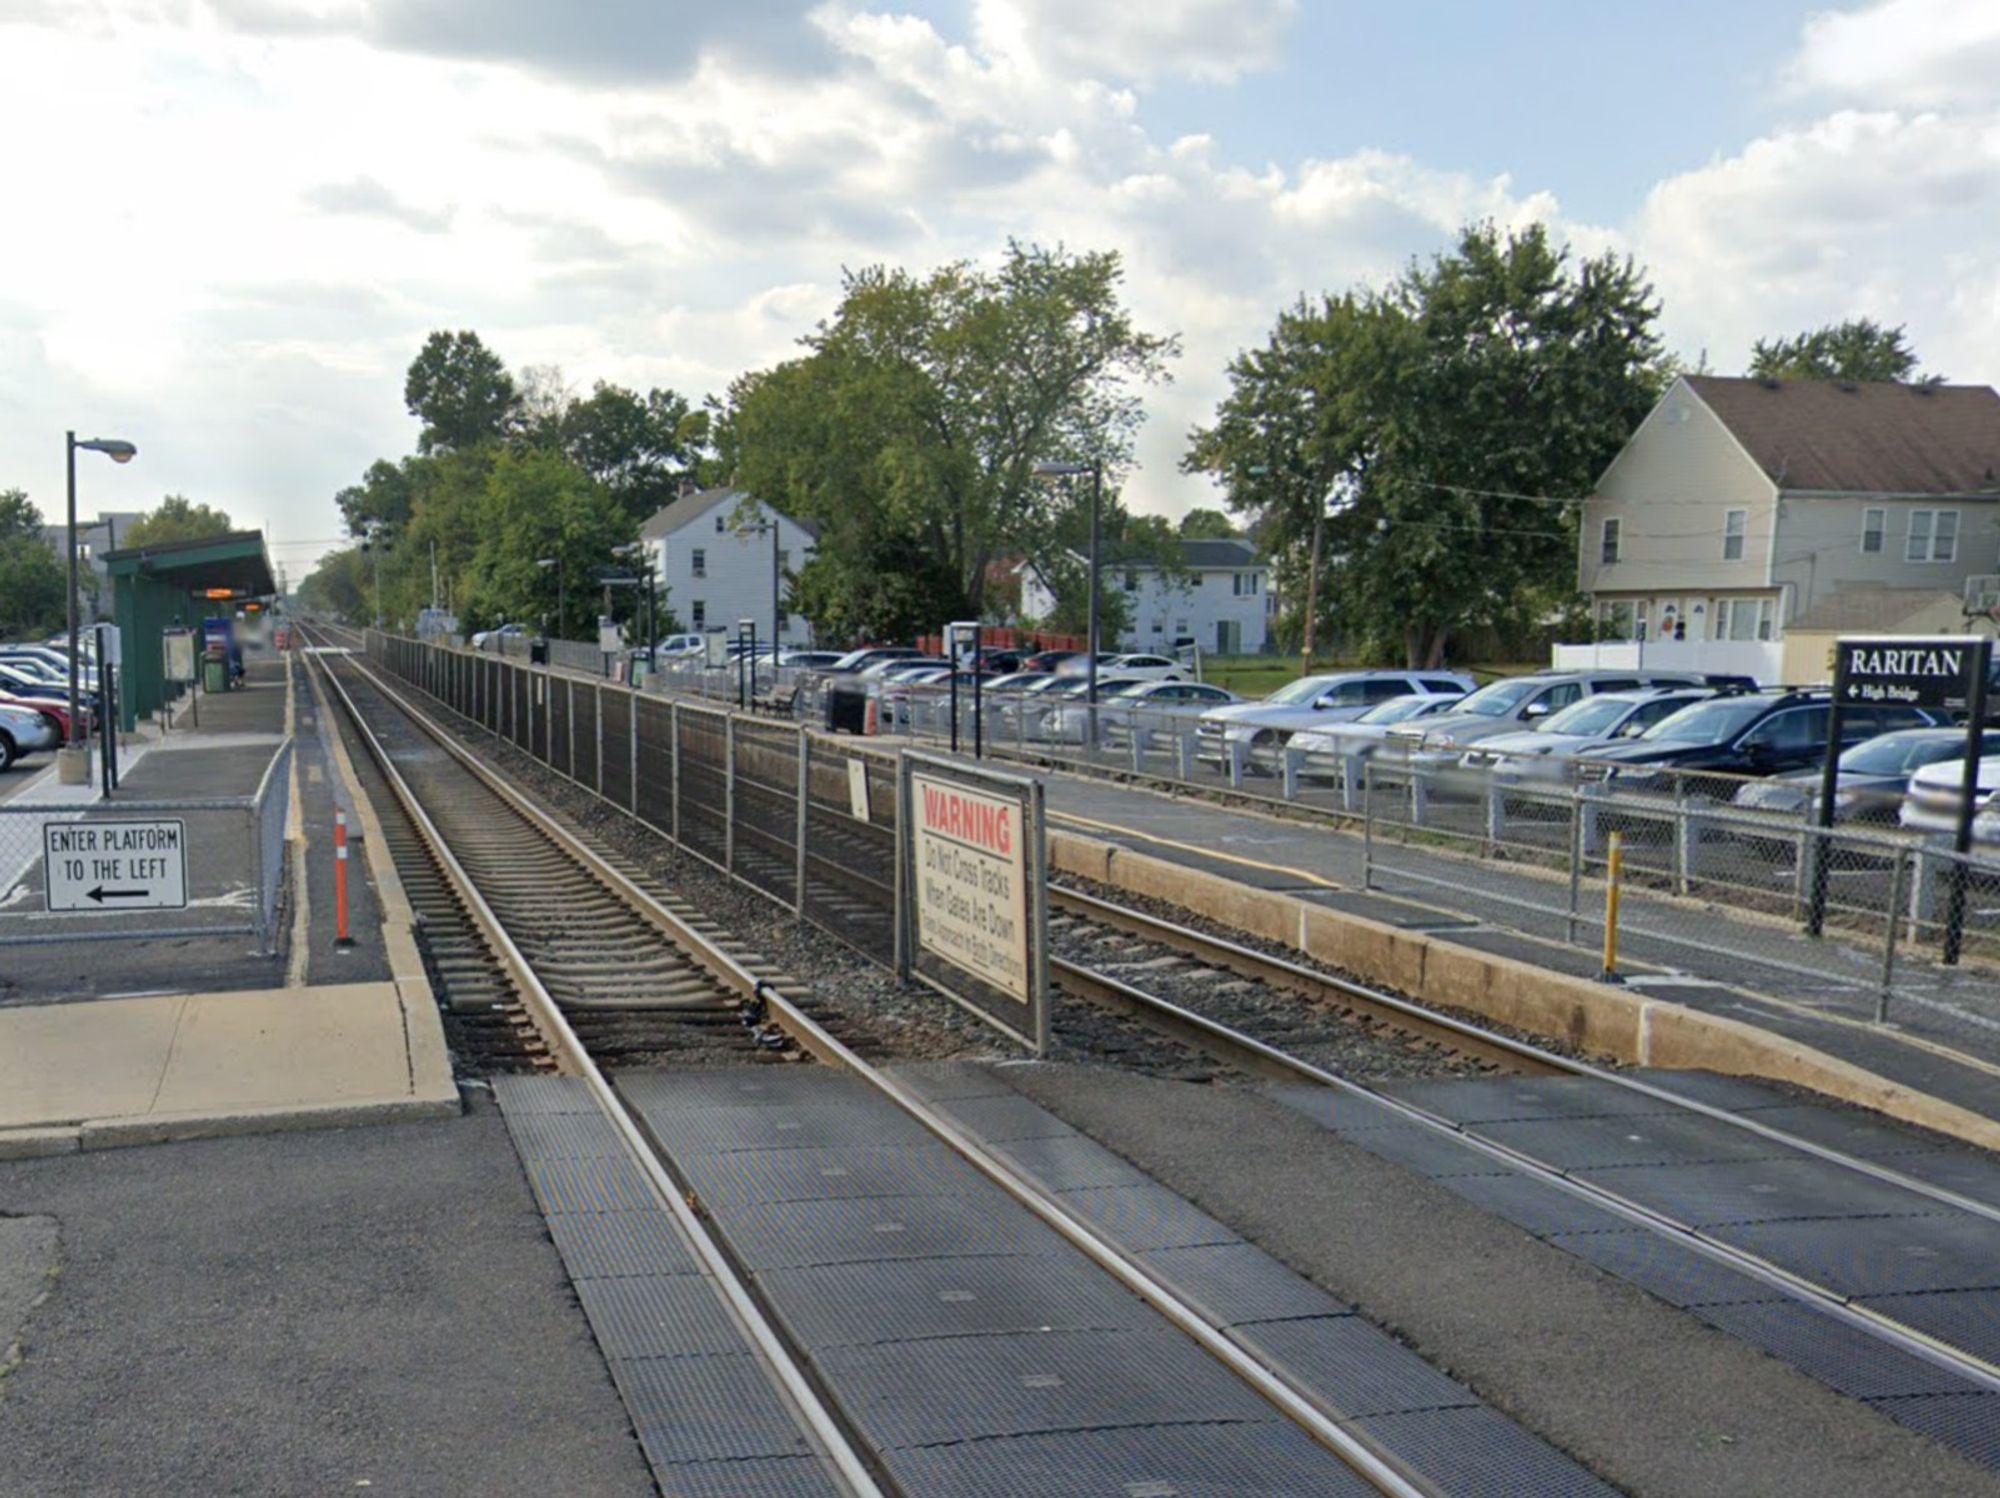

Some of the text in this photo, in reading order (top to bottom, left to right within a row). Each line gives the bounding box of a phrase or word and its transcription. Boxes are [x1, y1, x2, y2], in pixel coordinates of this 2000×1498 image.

[1850, 649, 1963, 676] RARITAN
[1861, 684, 1920, 702] High Bridge
[925, 787, 1010, 854] WARNING
[51, 828, 178, 852] ENTER PLATFORM
[64, 858, 167, 881] TO THE LEFT
[925, 838, 1010, 900] Do Not Cross Tracks
[925, 876, 1015, 944] When Gates Are Down
